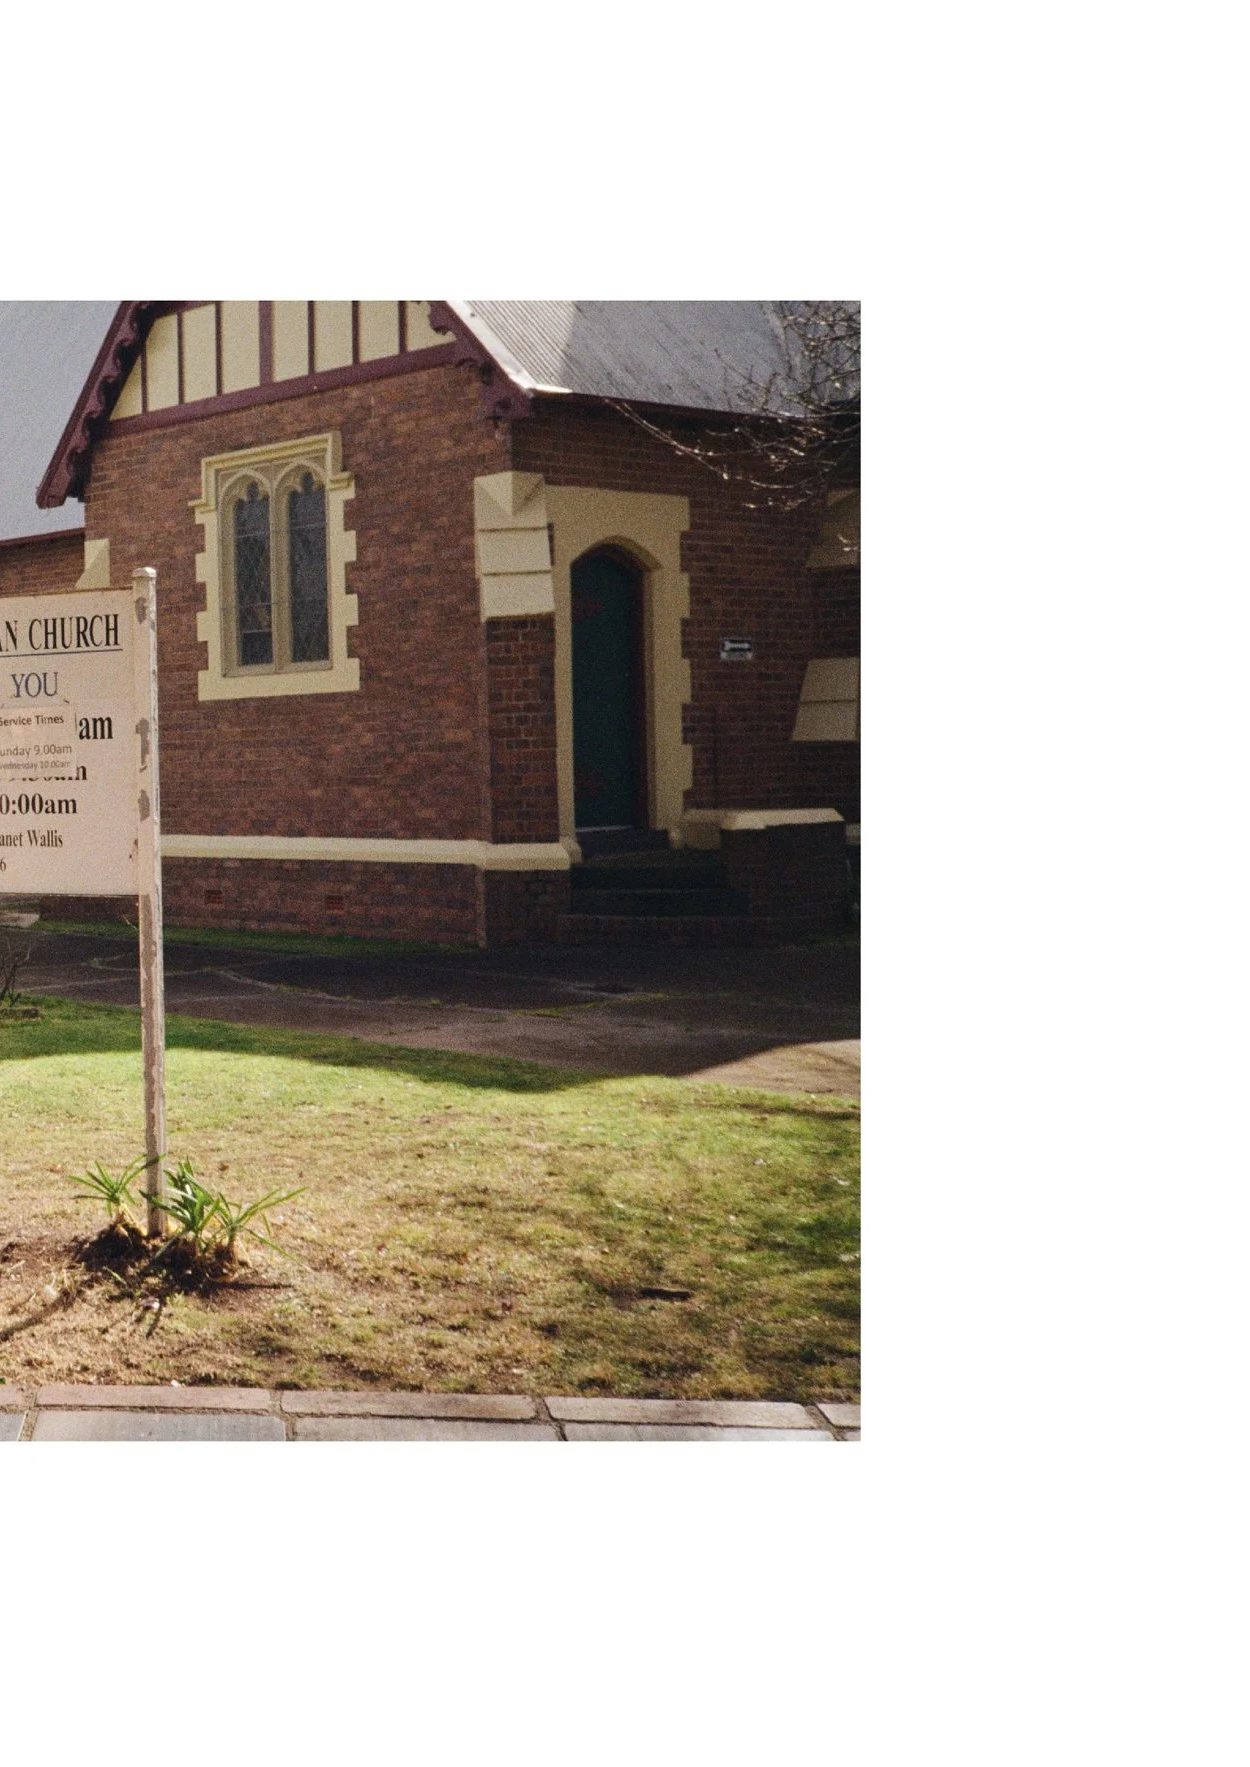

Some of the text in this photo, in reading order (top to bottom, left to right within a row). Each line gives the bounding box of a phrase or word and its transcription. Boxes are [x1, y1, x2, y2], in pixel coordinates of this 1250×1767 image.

[29, 613, 120, 649] CHURCH
[10, 672, 58, 698] YOU
[34, 715, 64, 725] Times
[27, 829, 63, 847] Wallis
